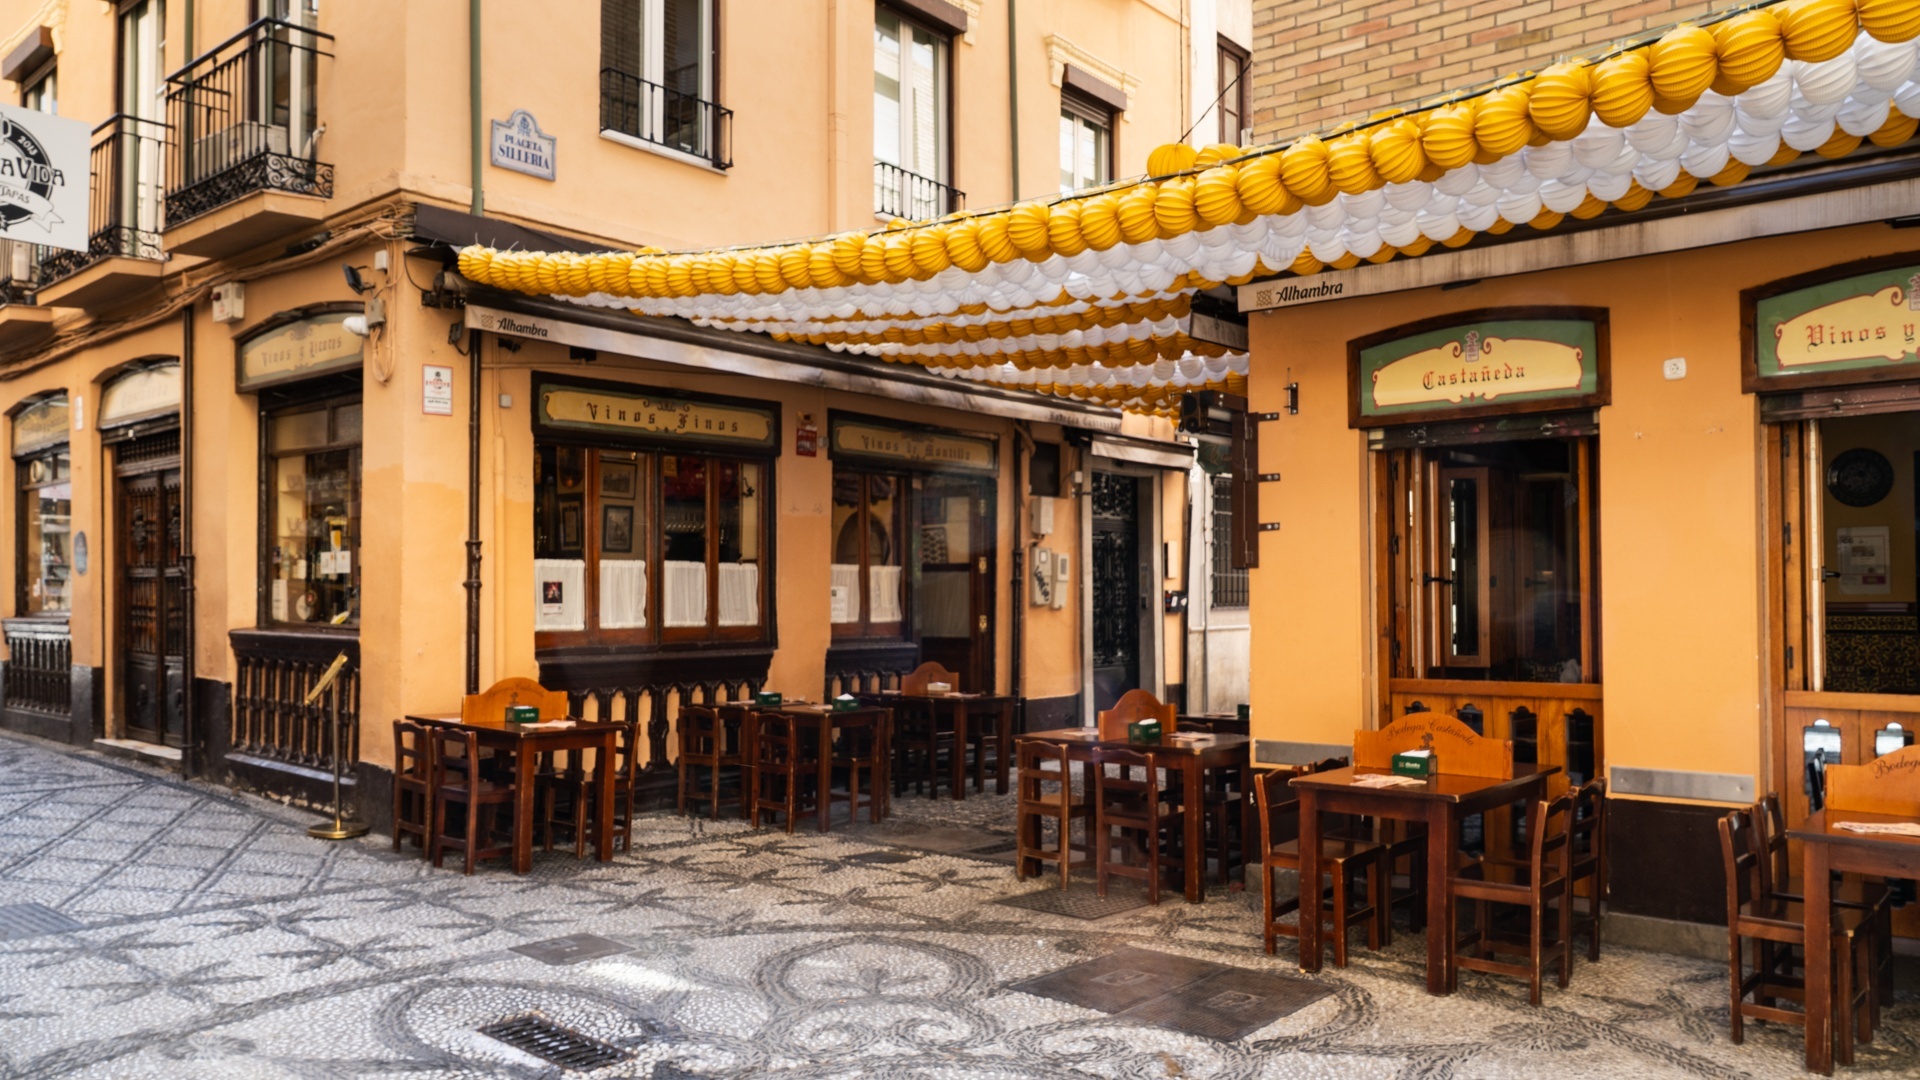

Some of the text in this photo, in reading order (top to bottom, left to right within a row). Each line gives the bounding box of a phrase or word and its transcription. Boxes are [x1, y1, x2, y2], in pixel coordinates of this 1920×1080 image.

[505, 134, 543, 152] PLACETA
[498, 144, 549, 169] SILLERIA
[1275, 281, 1344, 304] Alhambra
[497, 317, 548, 337] Alhambra
[1805, 323, 1915, 353] Vinos y
[1422, 362, 1525, 390] Castañeda
[586, 402, 739, 432] Vinos Finos
[861, 435, 899, 452] Vinos
[1387, 719, 1474, 746] Bodegas Castañeda
